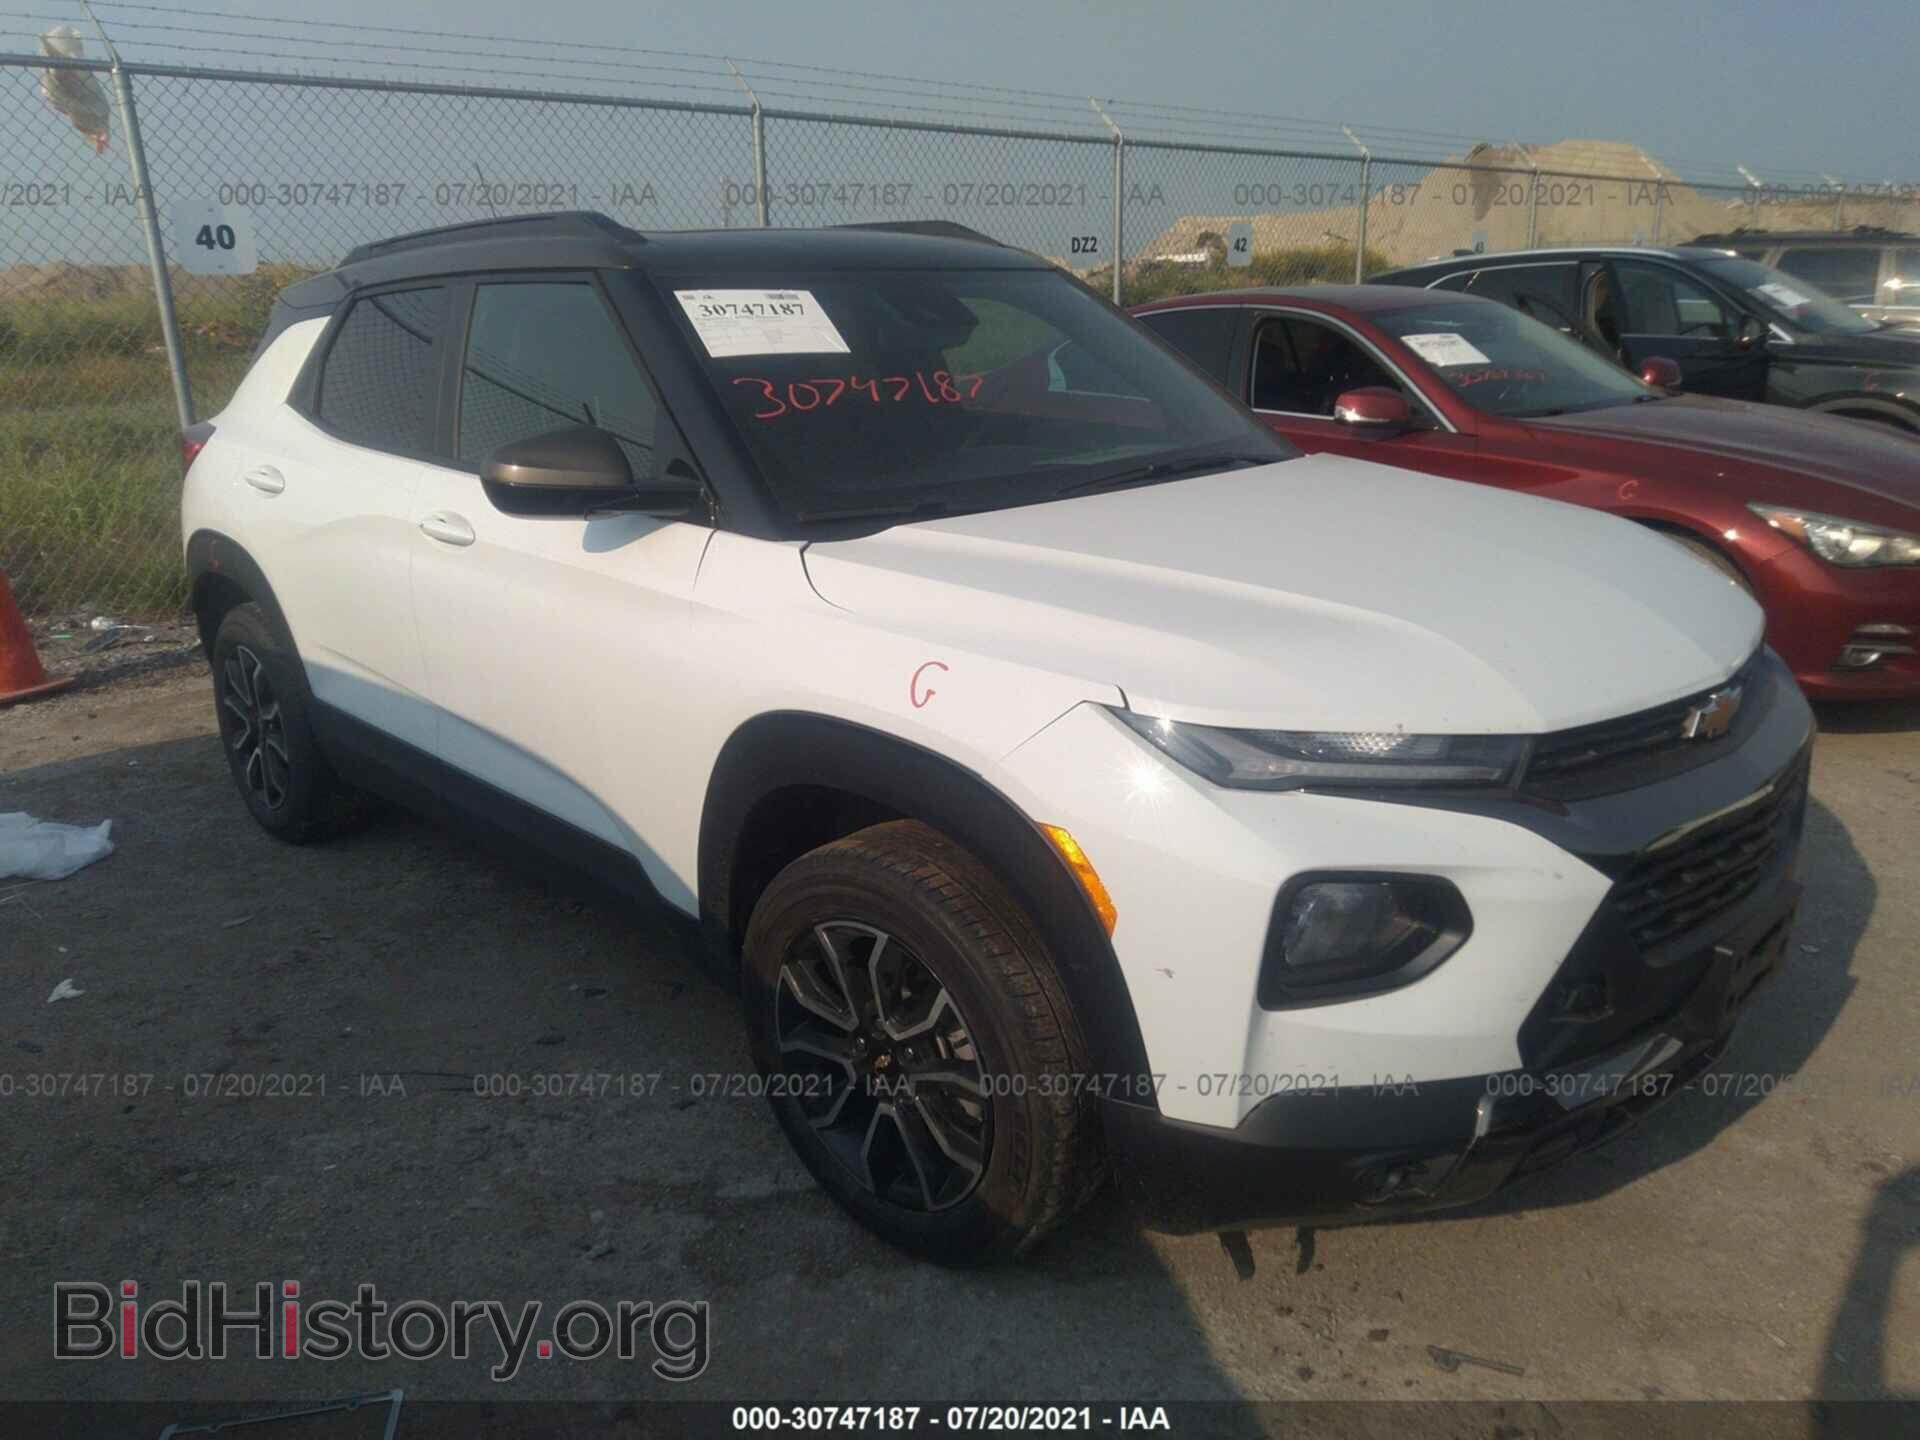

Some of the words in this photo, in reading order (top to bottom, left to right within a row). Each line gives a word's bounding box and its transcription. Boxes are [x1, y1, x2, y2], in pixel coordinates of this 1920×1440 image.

[195, 225, 236, 250] 40
[1071, 237, 1098, 253] DZ2
[1234, 238, 1248, 252] 42
[699, 303, 805, 318] 30747187
[733, 370, 985, 419] 30747187
